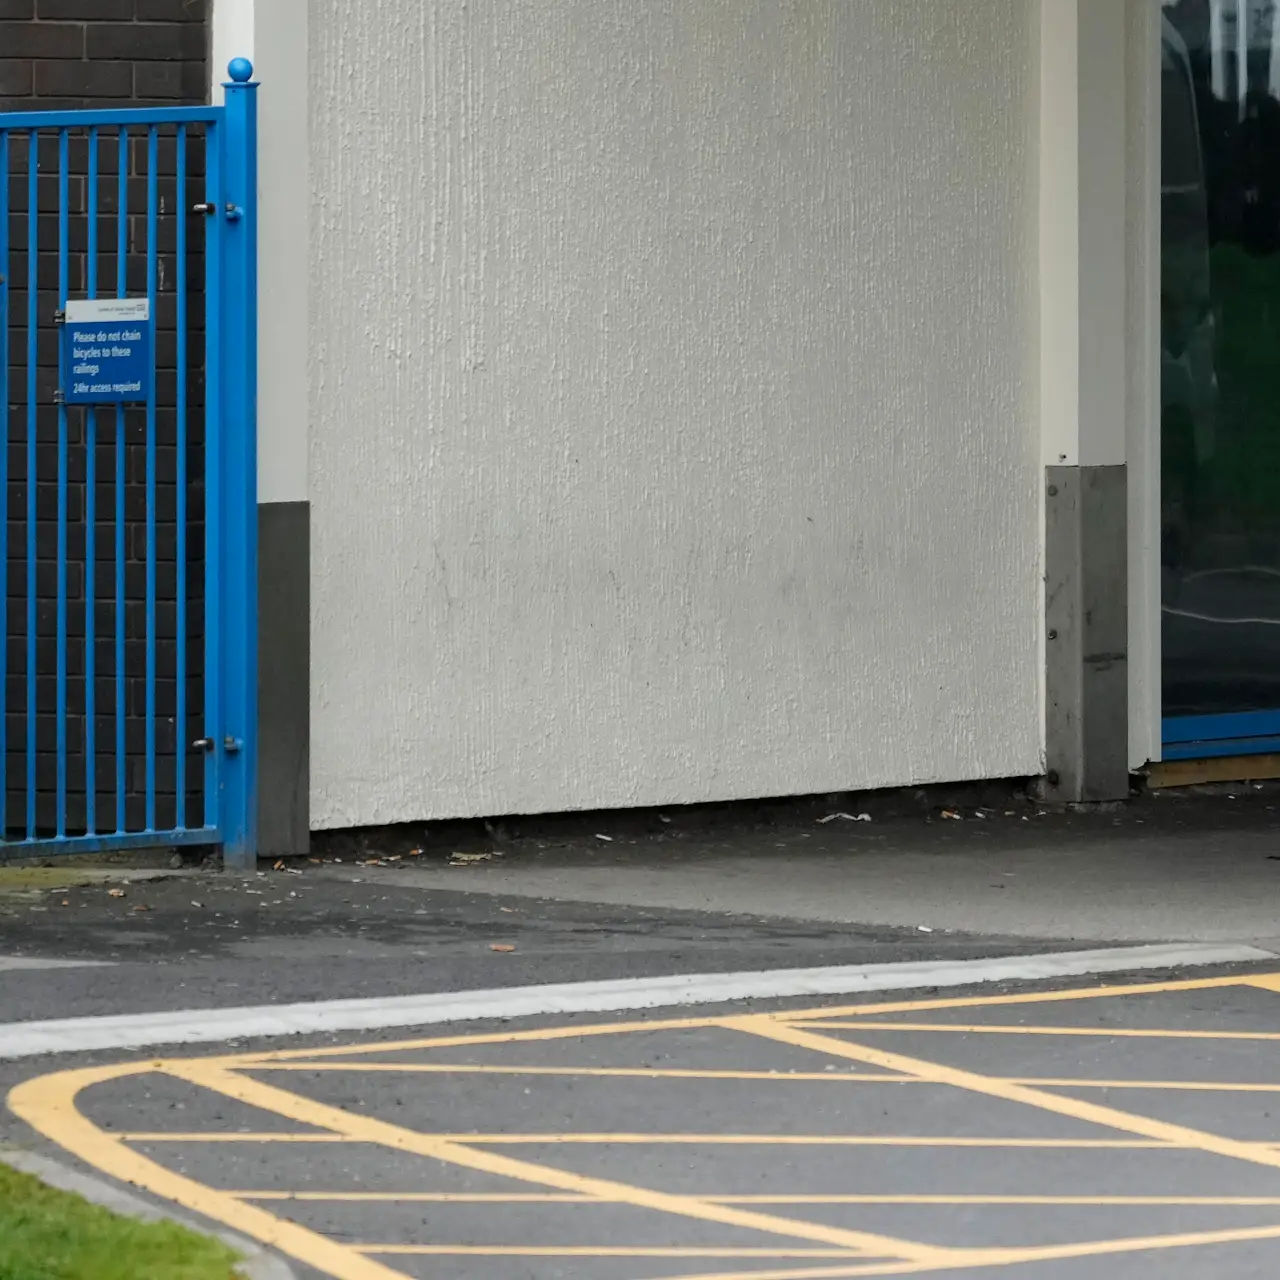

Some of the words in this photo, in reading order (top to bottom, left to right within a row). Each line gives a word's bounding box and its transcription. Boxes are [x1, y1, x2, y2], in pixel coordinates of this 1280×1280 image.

[73, 331, 96, 342] Please
[97, 331, 107, 342] do
[108, 331, 121, 341] not
[121, 329, 141, 341] chain
[73, 346, 101, 361] bicycles
[102, 347, 110, 357] to
[111, 346, 131, 357] these
[73, 362, 99, 376] railings
[73, 381, 90, 394] 24hr
[90, 383, 111, 393] access
[112, 380, 141, 395] required
